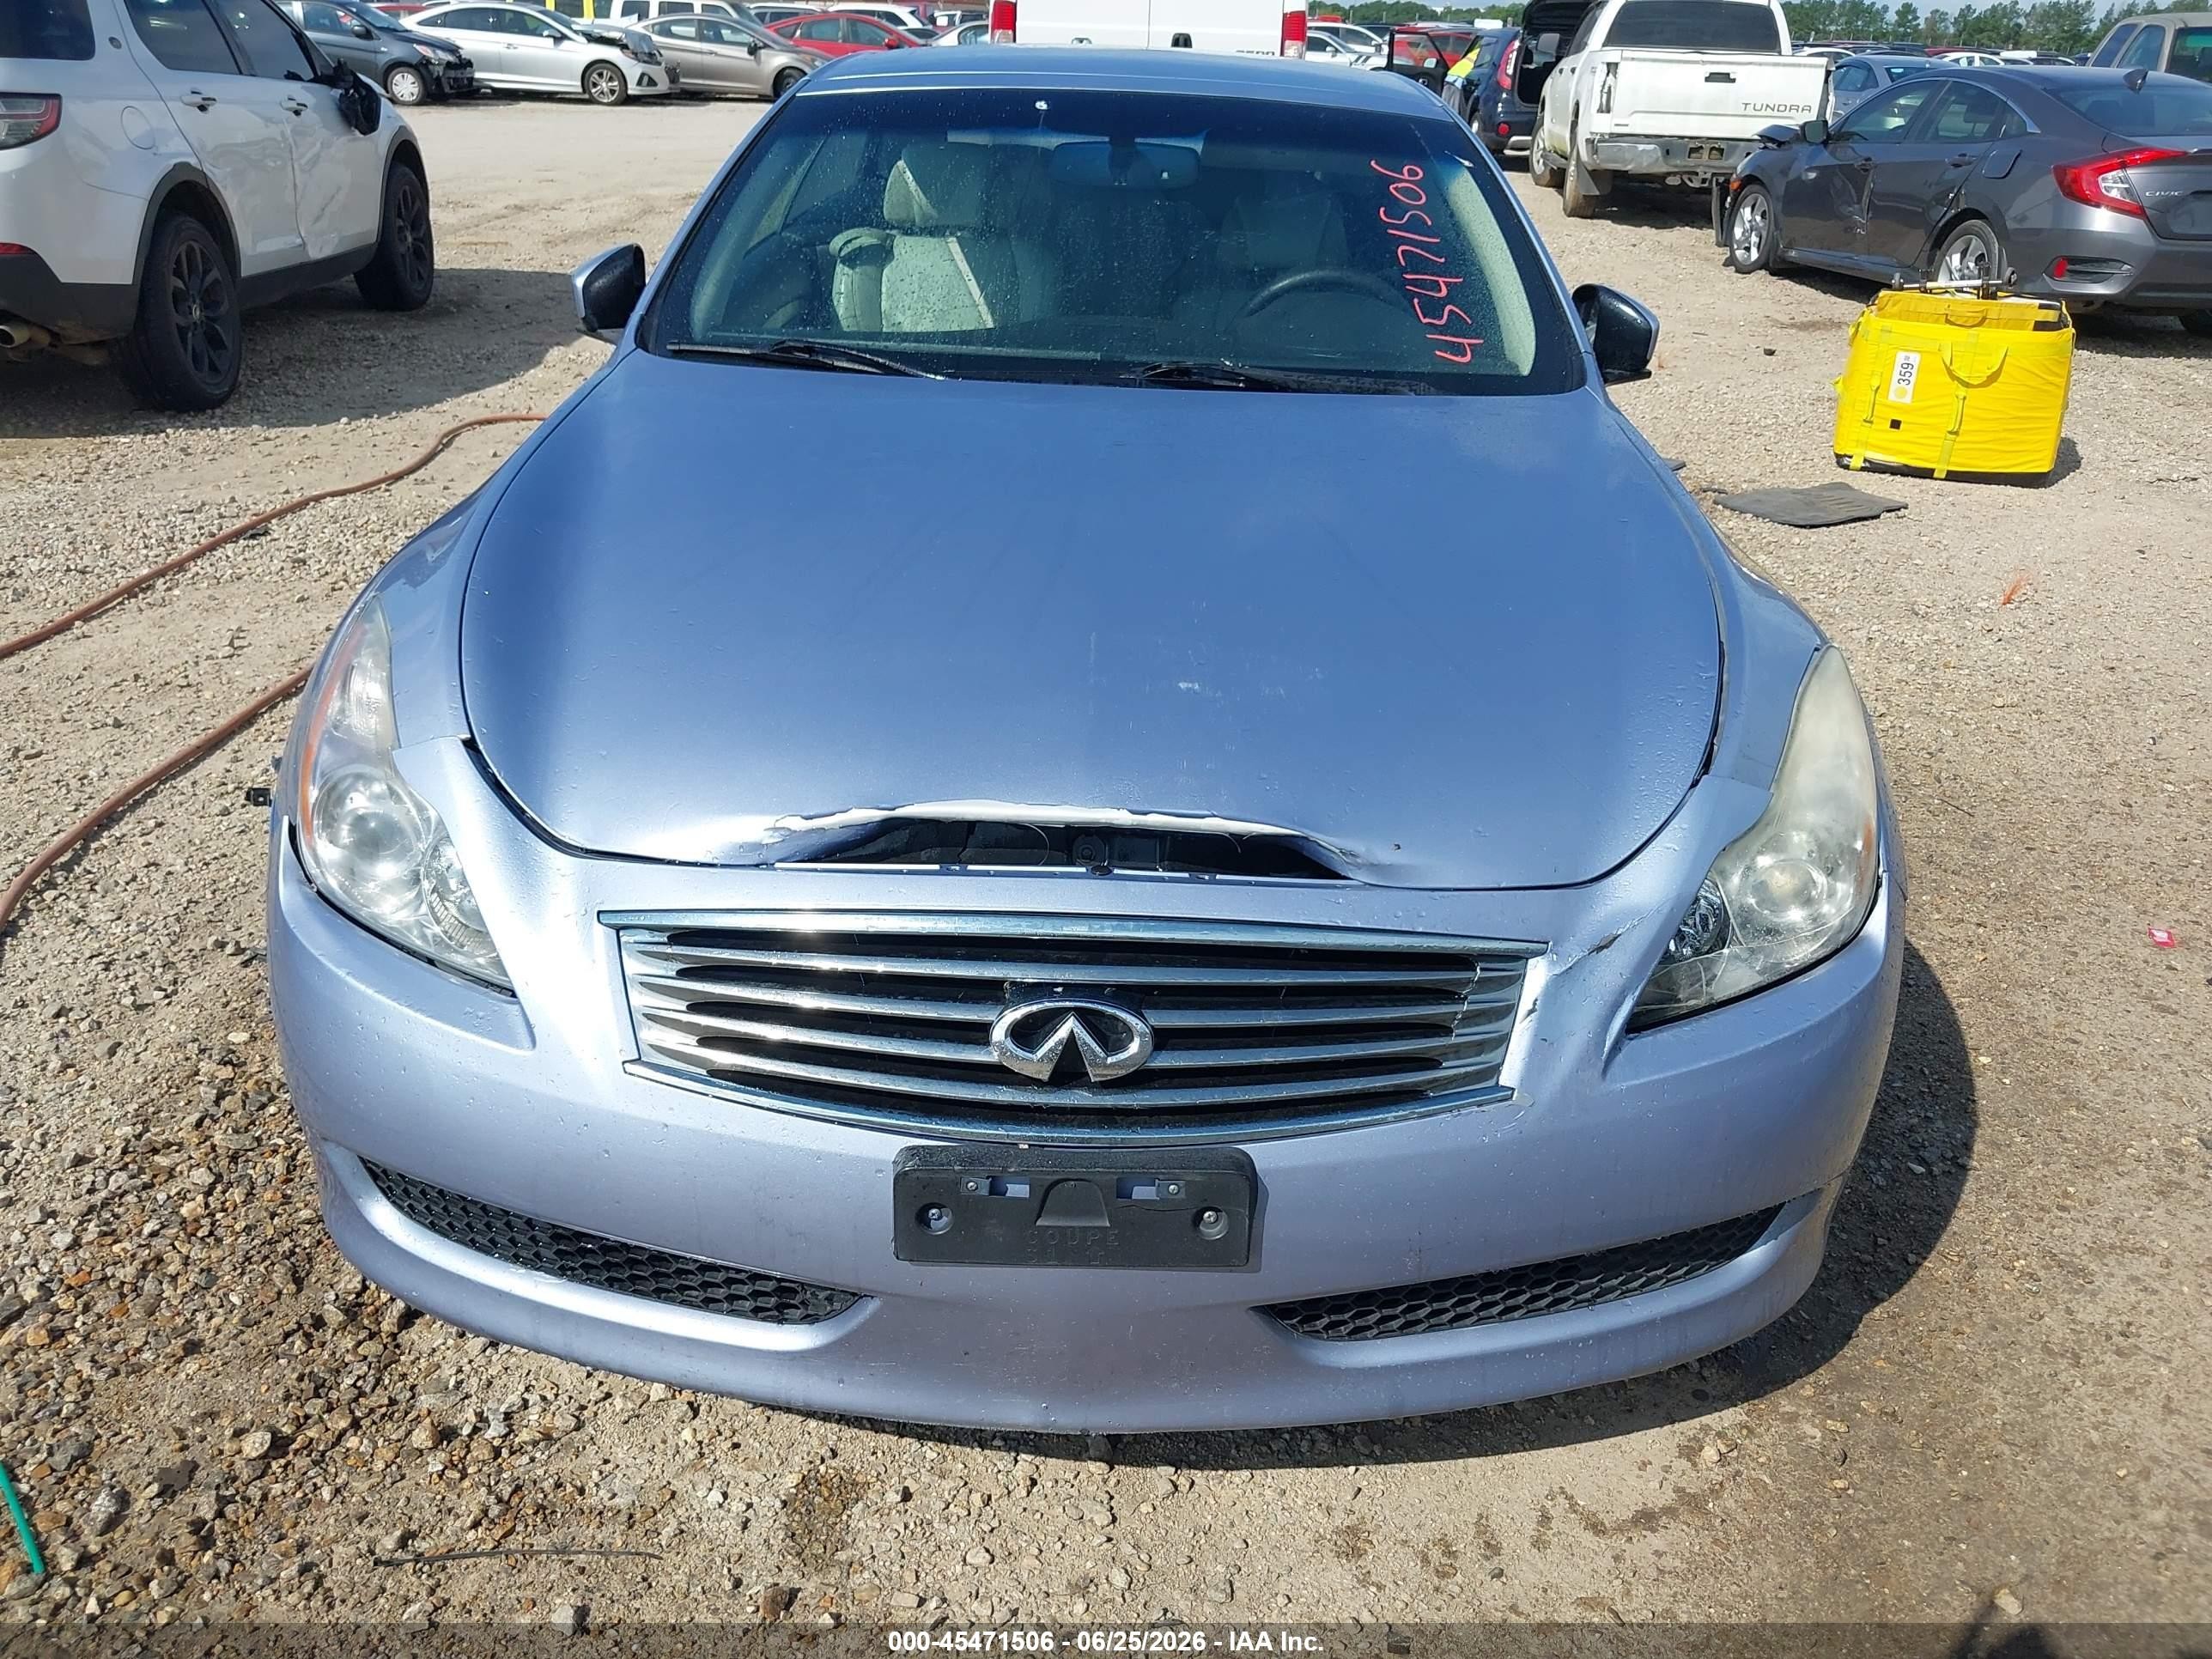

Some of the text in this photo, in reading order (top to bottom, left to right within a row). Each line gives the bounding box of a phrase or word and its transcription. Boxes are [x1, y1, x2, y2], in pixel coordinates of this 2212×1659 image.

[1741, 102, 1812, 113] TUNDRA
[1370, 160, 1485, 362] 45471506
[1897, 362, 1914, 386] 359
